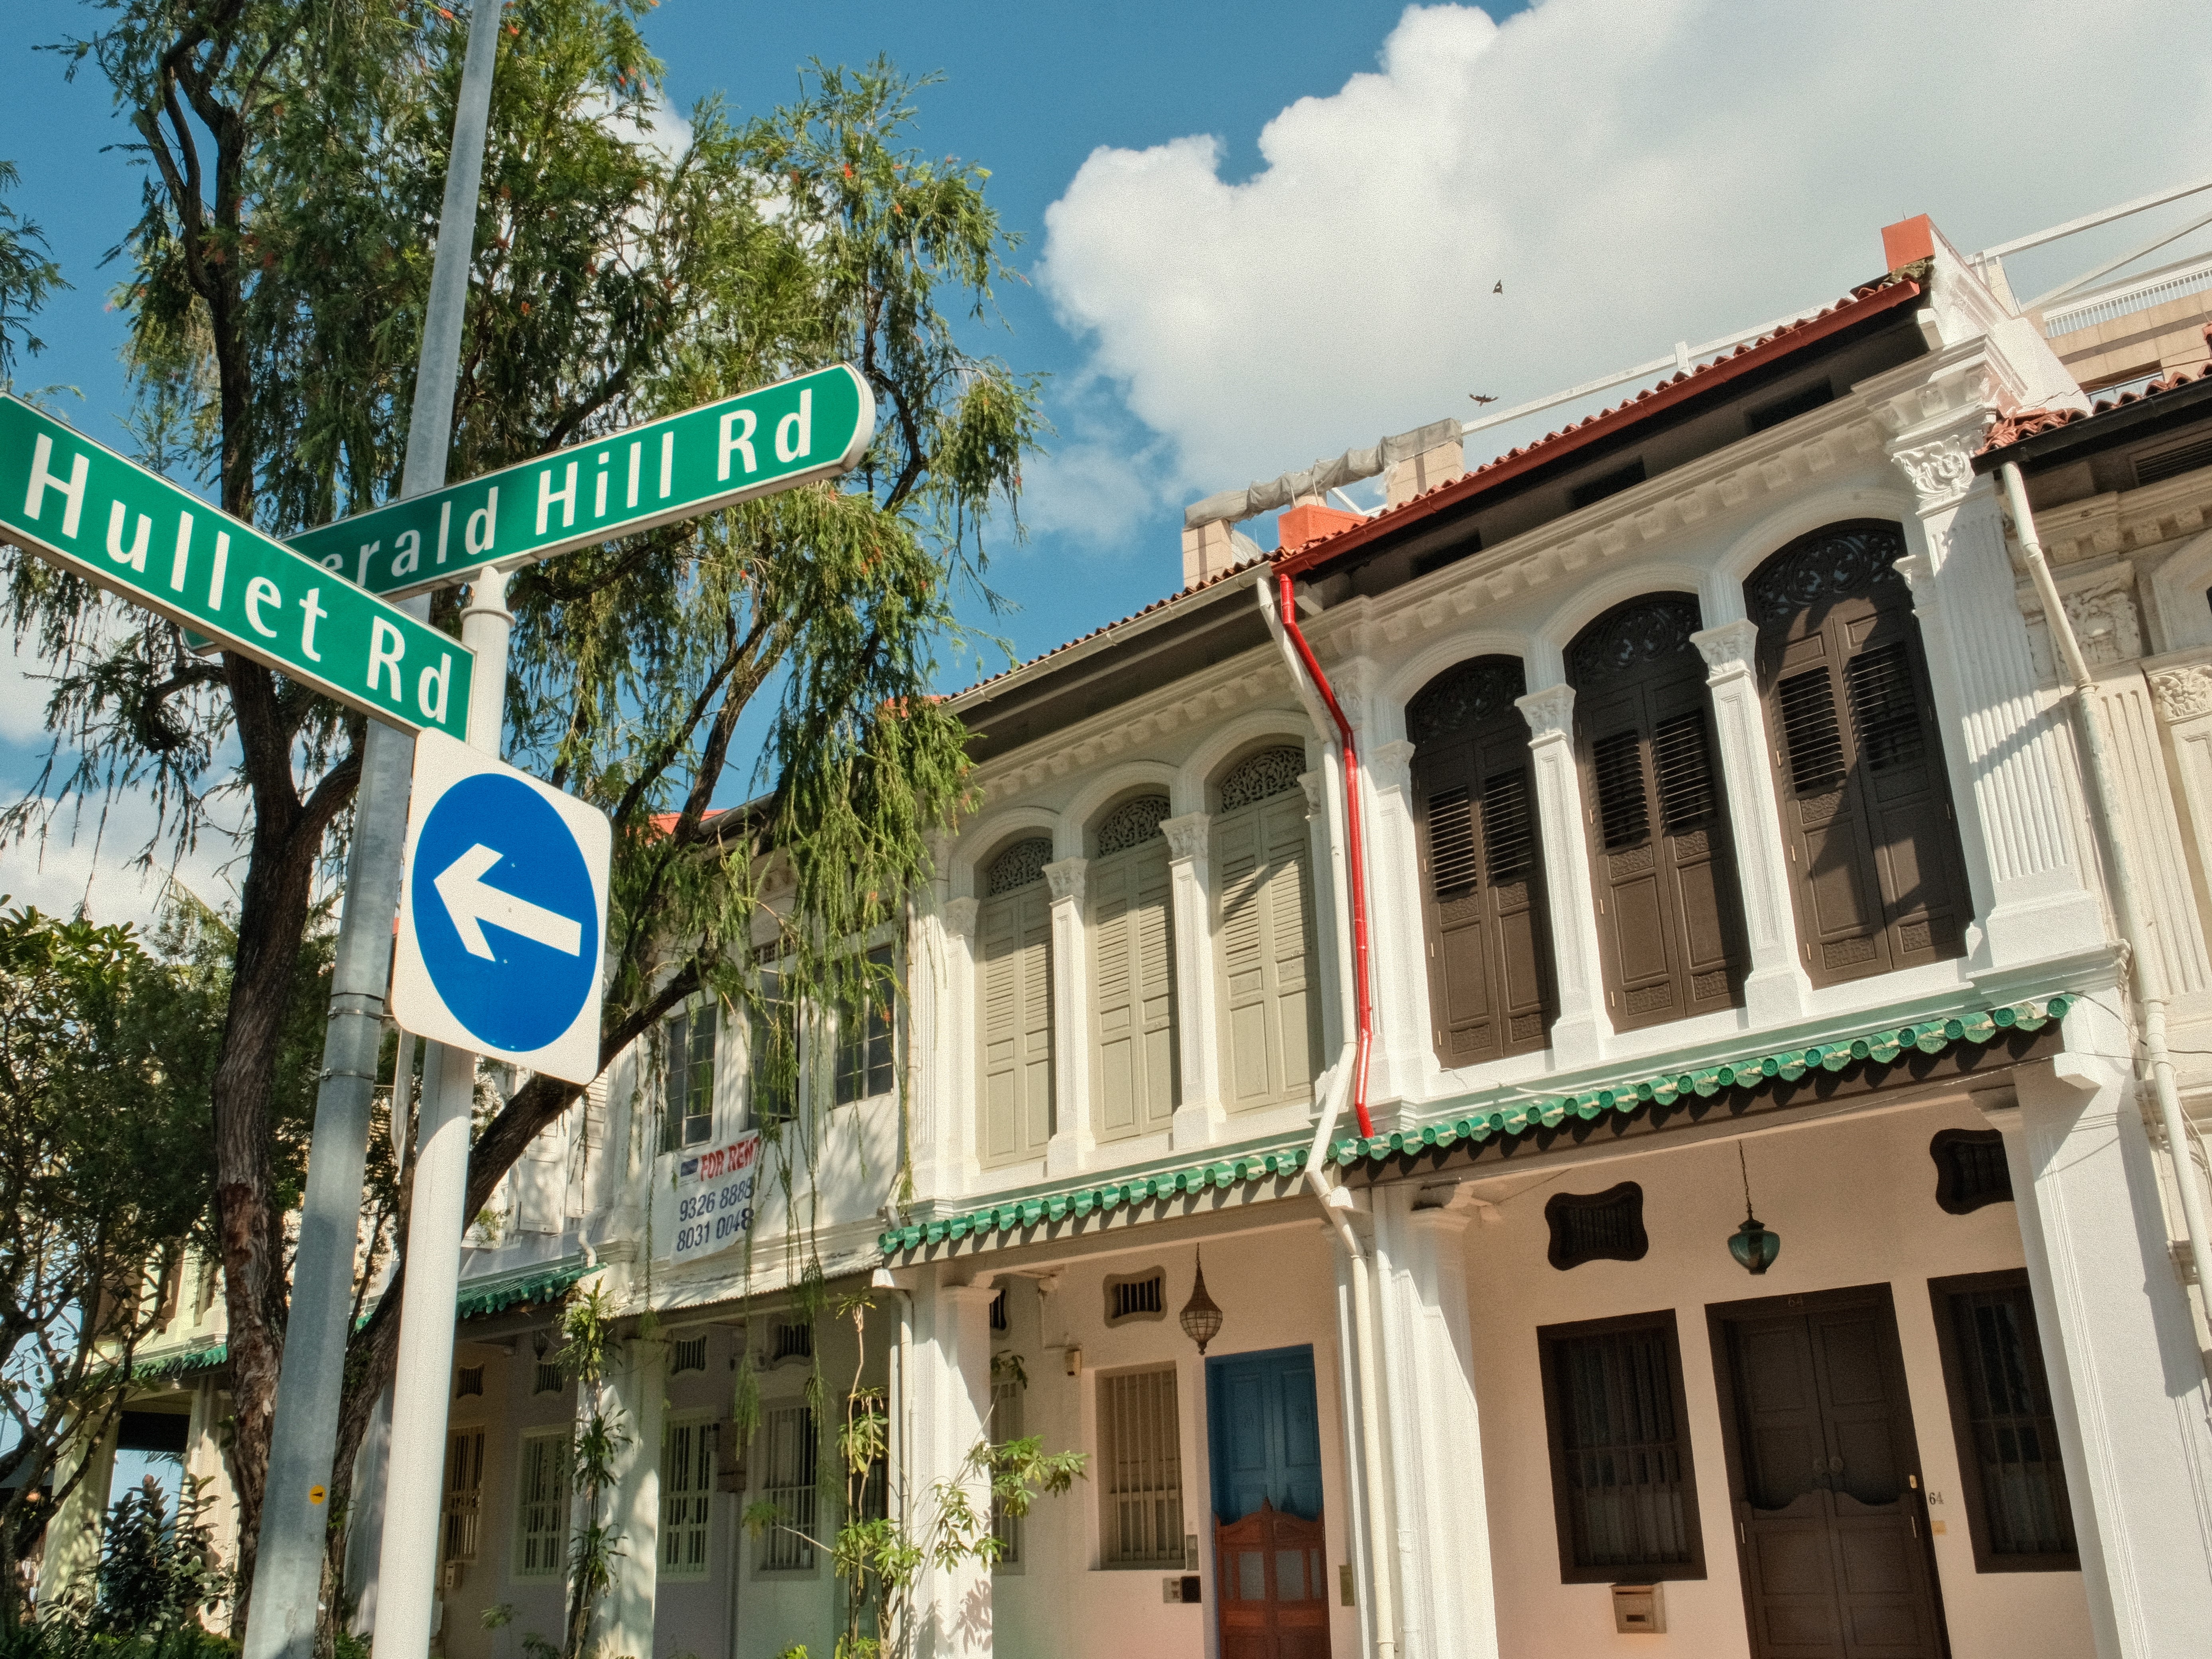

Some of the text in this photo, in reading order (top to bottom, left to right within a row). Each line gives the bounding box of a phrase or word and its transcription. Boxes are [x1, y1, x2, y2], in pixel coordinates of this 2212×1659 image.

[536, 431, 674, 536] Hill
[718, 389, 812, 481] Rd
[24, 433, 451, 724] Hullet Rd
[701, 1150, 724, 1181] FOR
[680, 1191, 716, 1222] 9326
[677, 1208, 754, 1251] 8031 0048
[1929, 1492, 1944, 1505] 64
